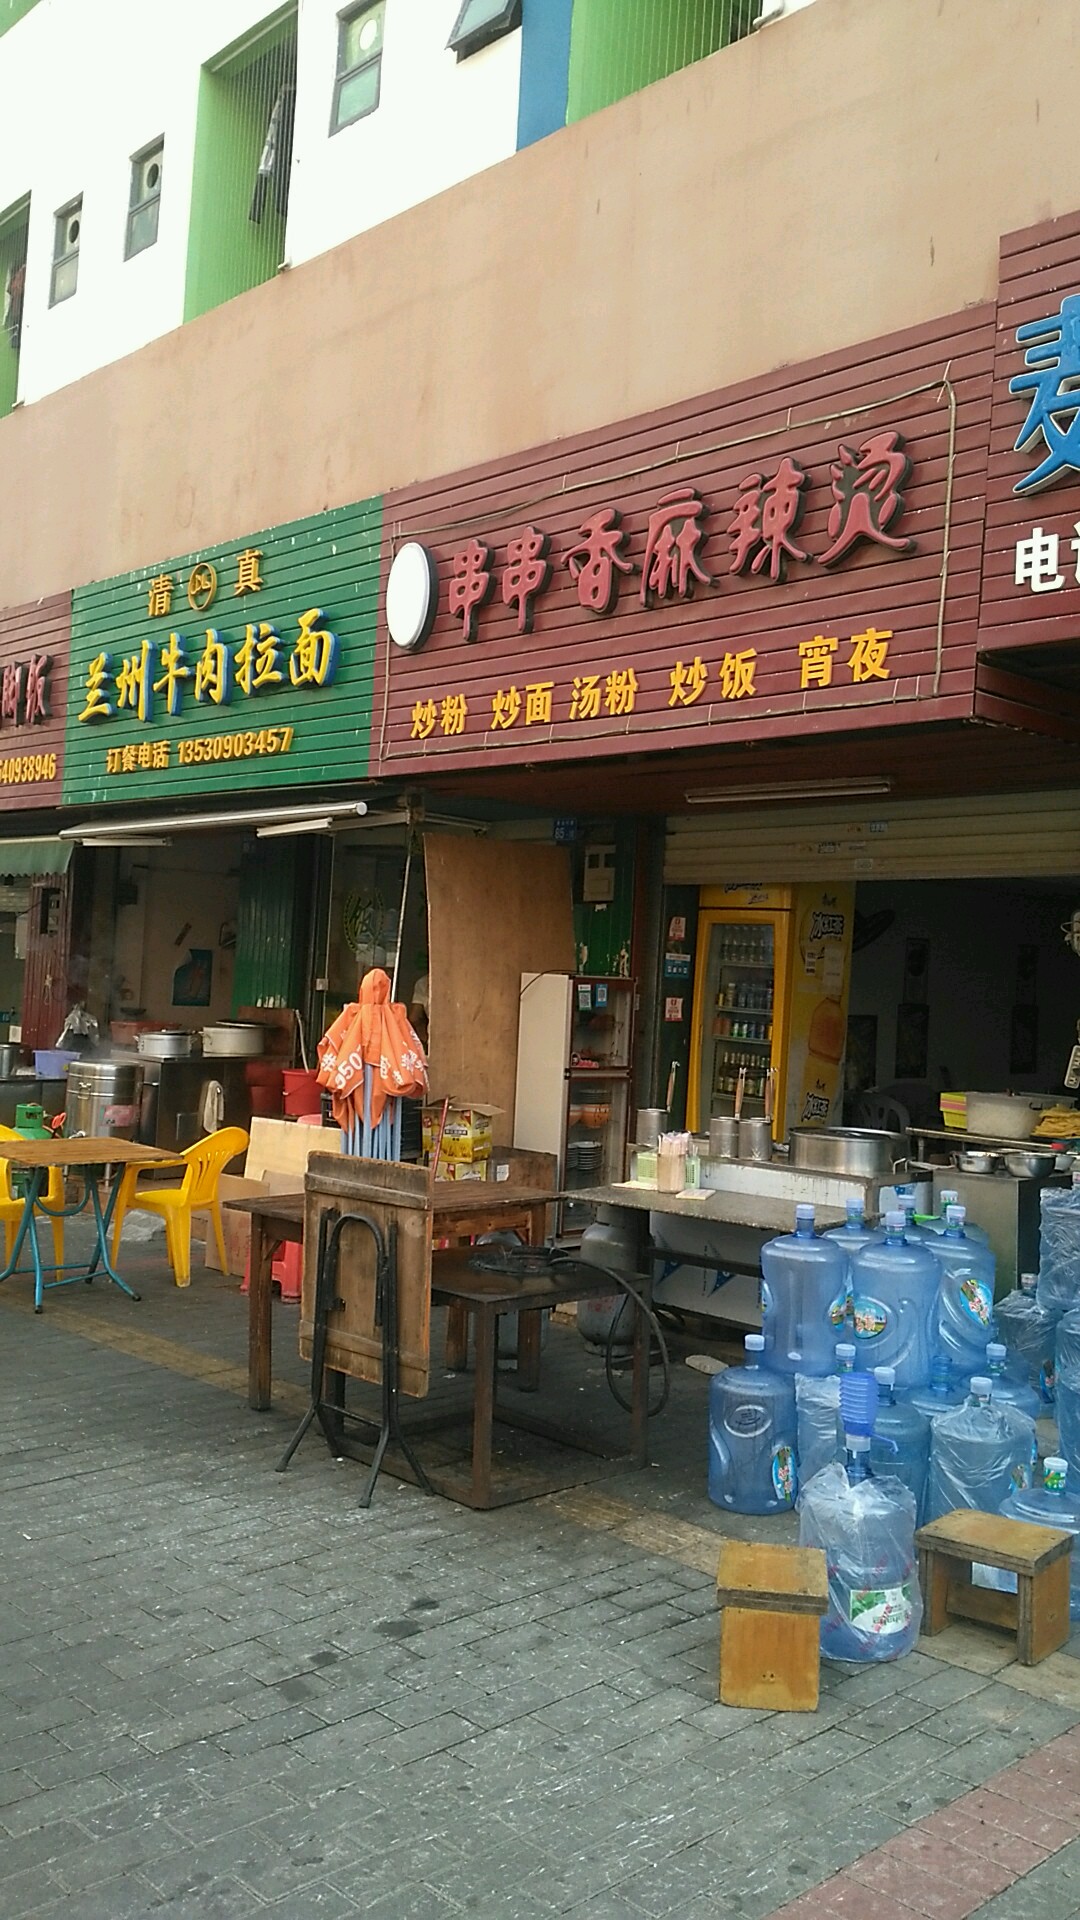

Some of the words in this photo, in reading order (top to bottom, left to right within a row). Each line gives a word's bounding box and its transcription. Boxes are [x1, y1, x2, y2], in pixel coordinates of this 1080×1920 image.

[147, 574, 174, 617] 清
[233, 548, 264, 597] 真
[448, 430, 917, 643] 串串香麻辣烫
[1015, 520, 1080, 593] 电
[78, 608, 341, 723] 兰州牛肉拉面
[410, 694, 467, 739] 炒粉
[490, 681, 555, 731] 炒面
[569, 667, 638, 721] 汤粉
[669, 648, 758, 707] 炒饭
[798, 627, 894, 689] 宵夜
[106, 741, 171, 774] 订餐电话
[177, 727, 294, 764] 13530903457
